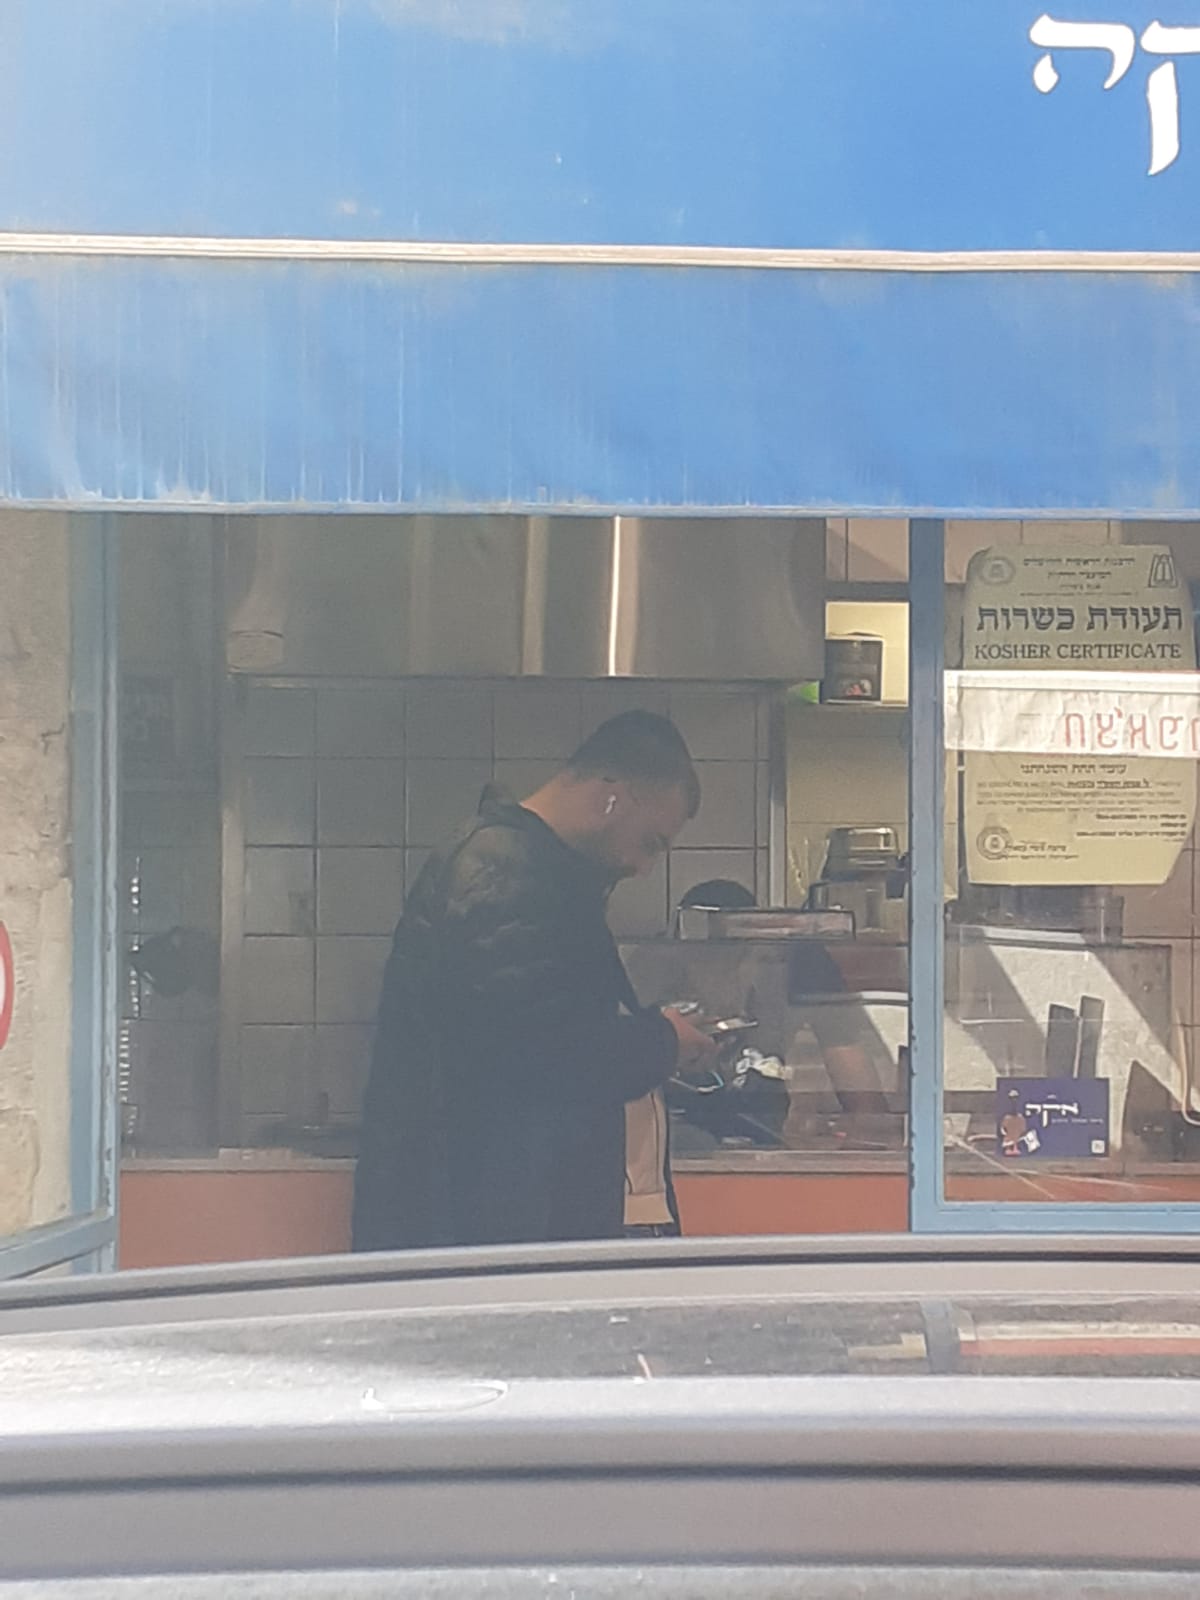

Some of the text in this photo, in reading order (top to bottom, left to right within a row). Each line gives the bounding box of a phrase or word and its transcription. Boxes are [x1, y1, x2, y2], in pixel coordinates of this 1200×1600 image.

[976, 605, 1183, 633] תעודת כשרות
[974, 643, 1182, 660] KOSHER CERTIFICATE
